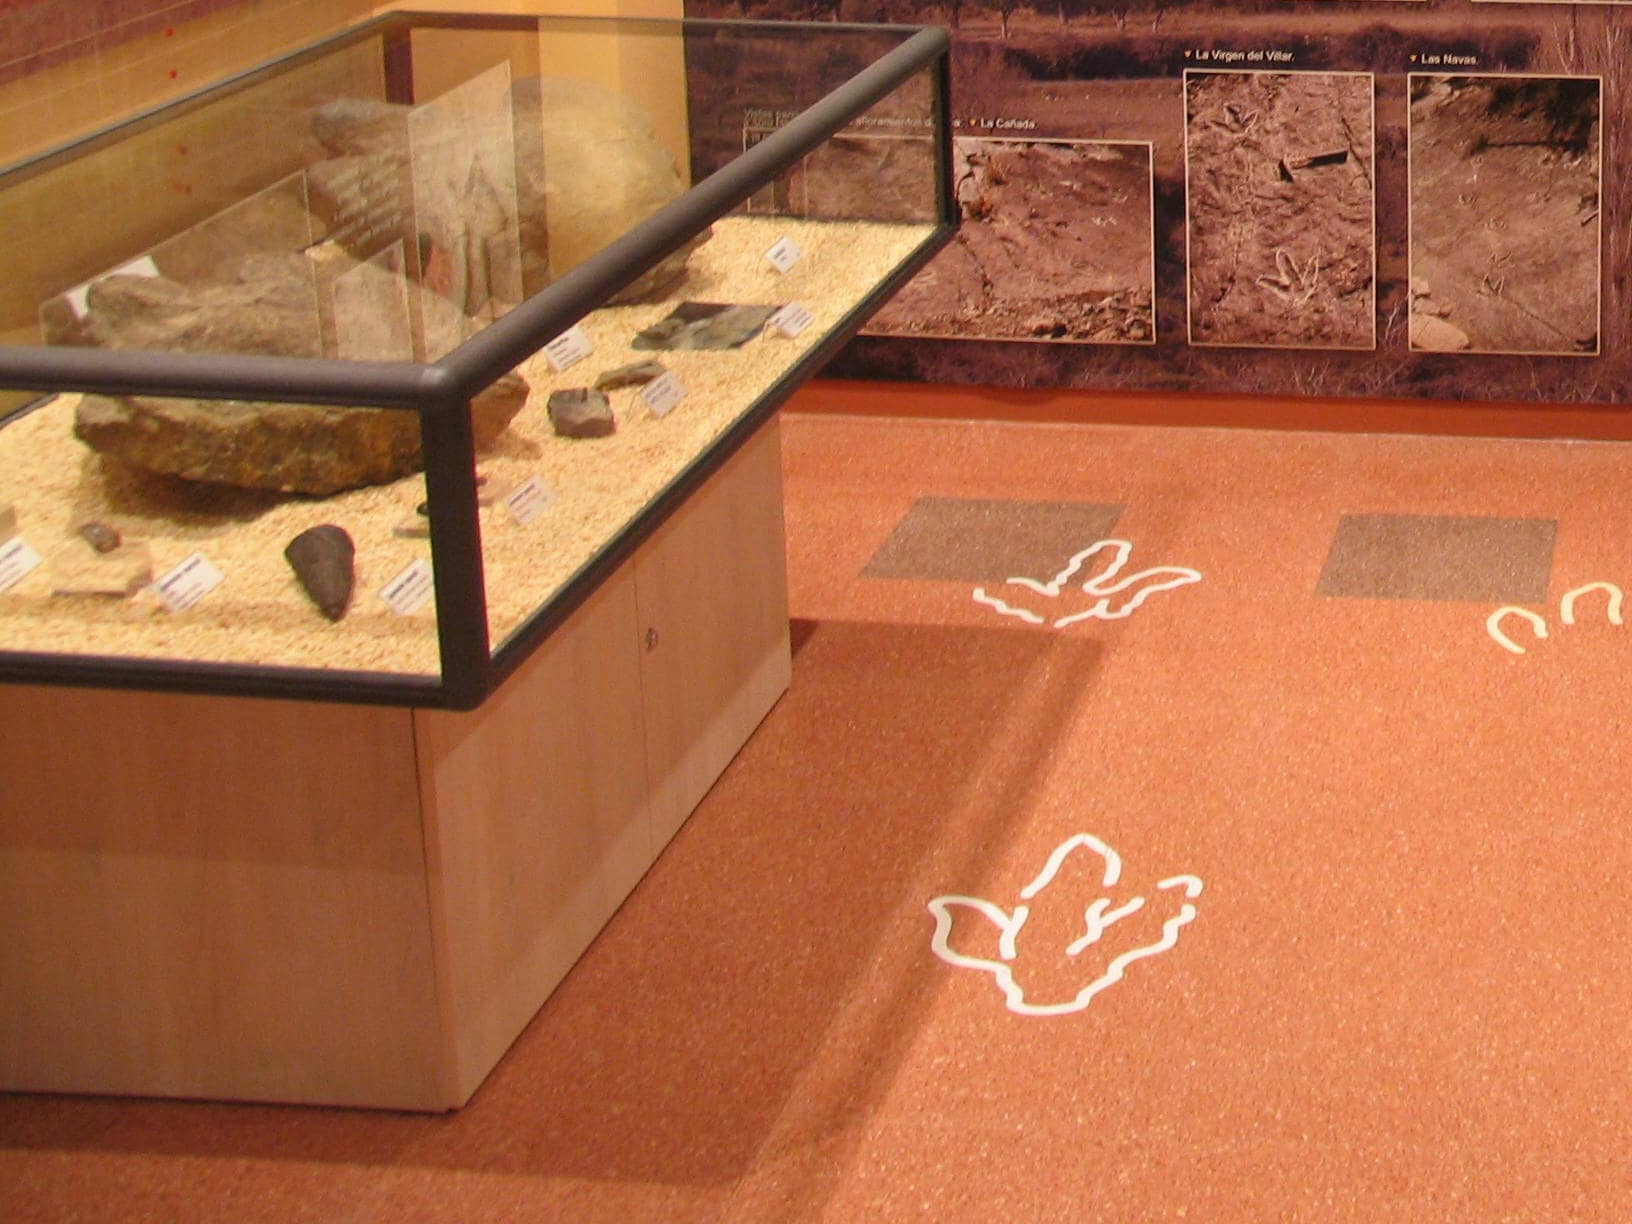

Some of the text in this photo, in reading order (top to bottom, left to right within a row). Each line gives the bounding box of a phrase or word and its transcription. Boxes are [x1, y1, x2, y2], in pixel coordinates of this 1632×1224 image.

[1195, 49, 1209, 60] La
[1211, 49, 1245, 63] Virgen
[1247, 50, 1263, 61] del
[1421, 53, 1441, 65] Las
[980, 118, 994, 128] La
